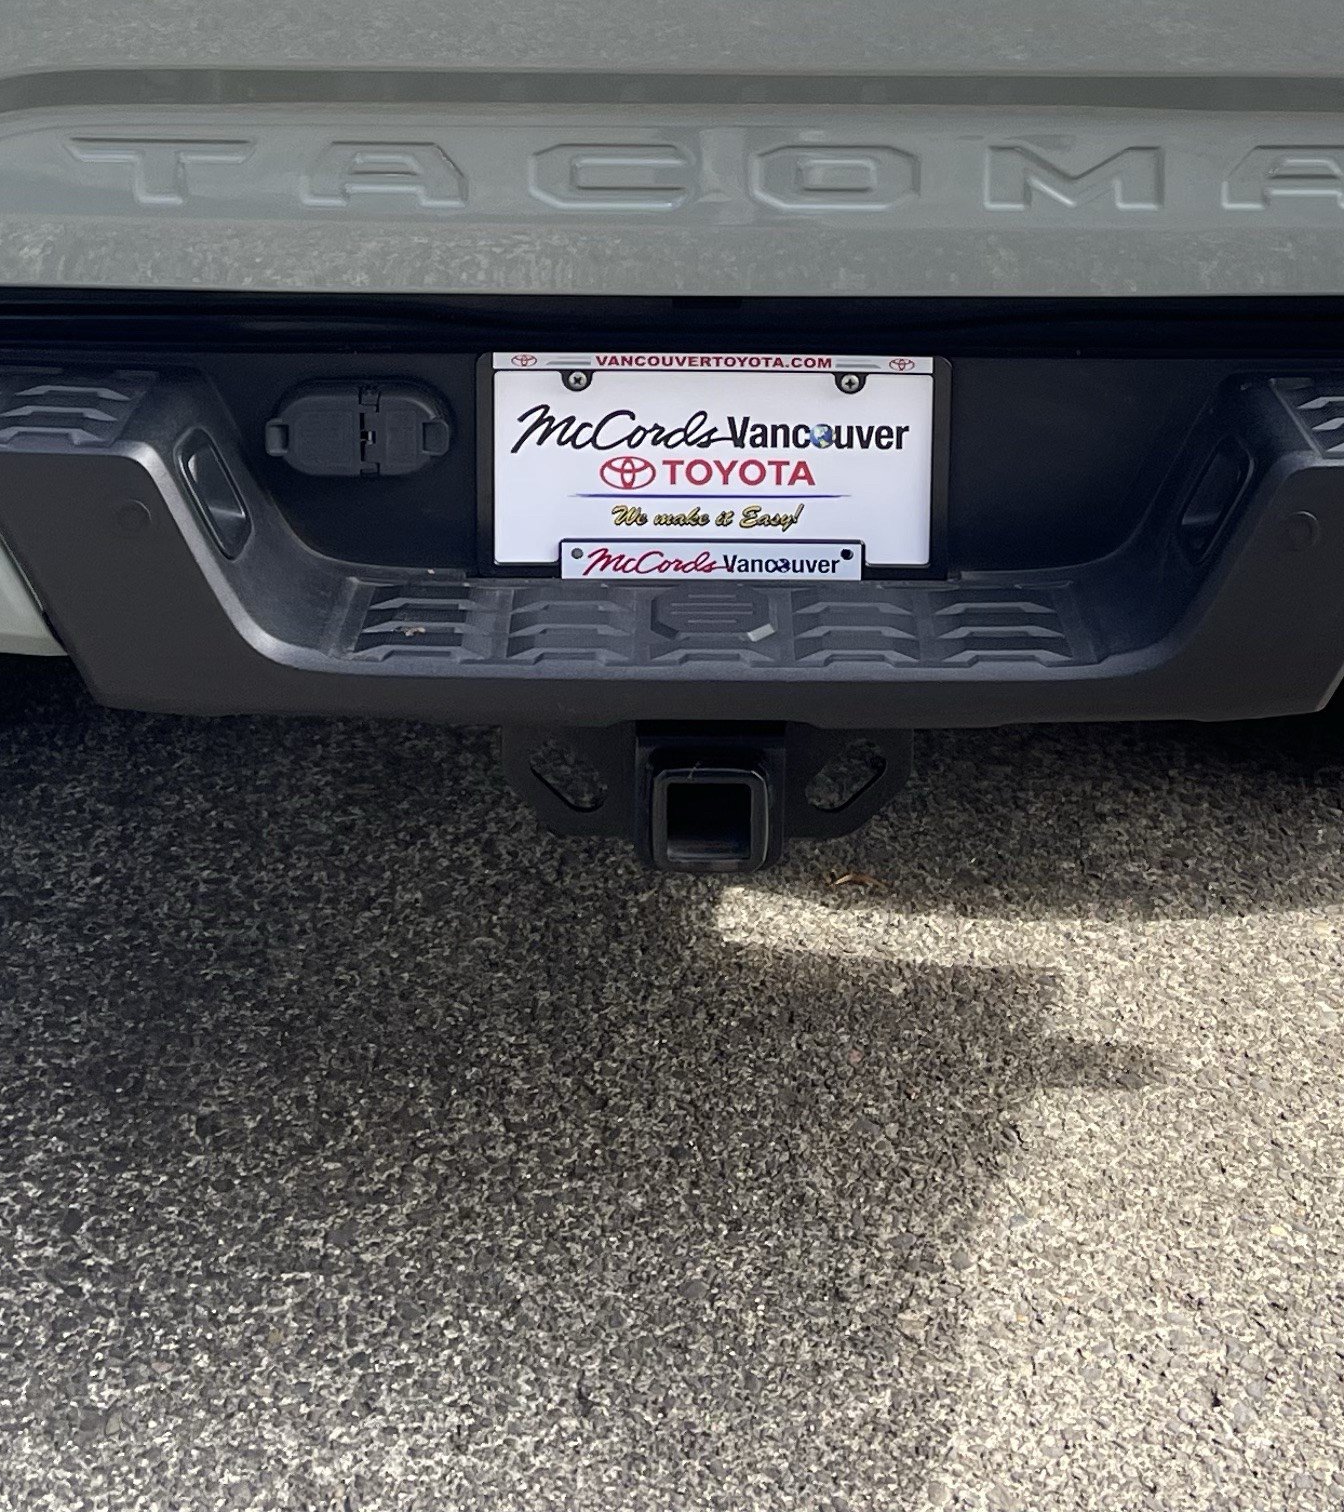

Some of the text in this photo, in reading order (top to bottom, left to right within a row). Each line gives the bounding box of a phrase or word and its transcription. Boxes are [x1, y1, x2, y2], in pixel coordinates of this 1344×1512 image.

[595, 355, 833, 370] VANCOUVERTOYOTA.COM
[510, 404, 910, 454] McCords Vancouver
[662, 459, 816, 487] TOYOTA
[612, 503, 805, 532] We make it Easy!
[582, 547, 840, 576] McCords Vancouver
